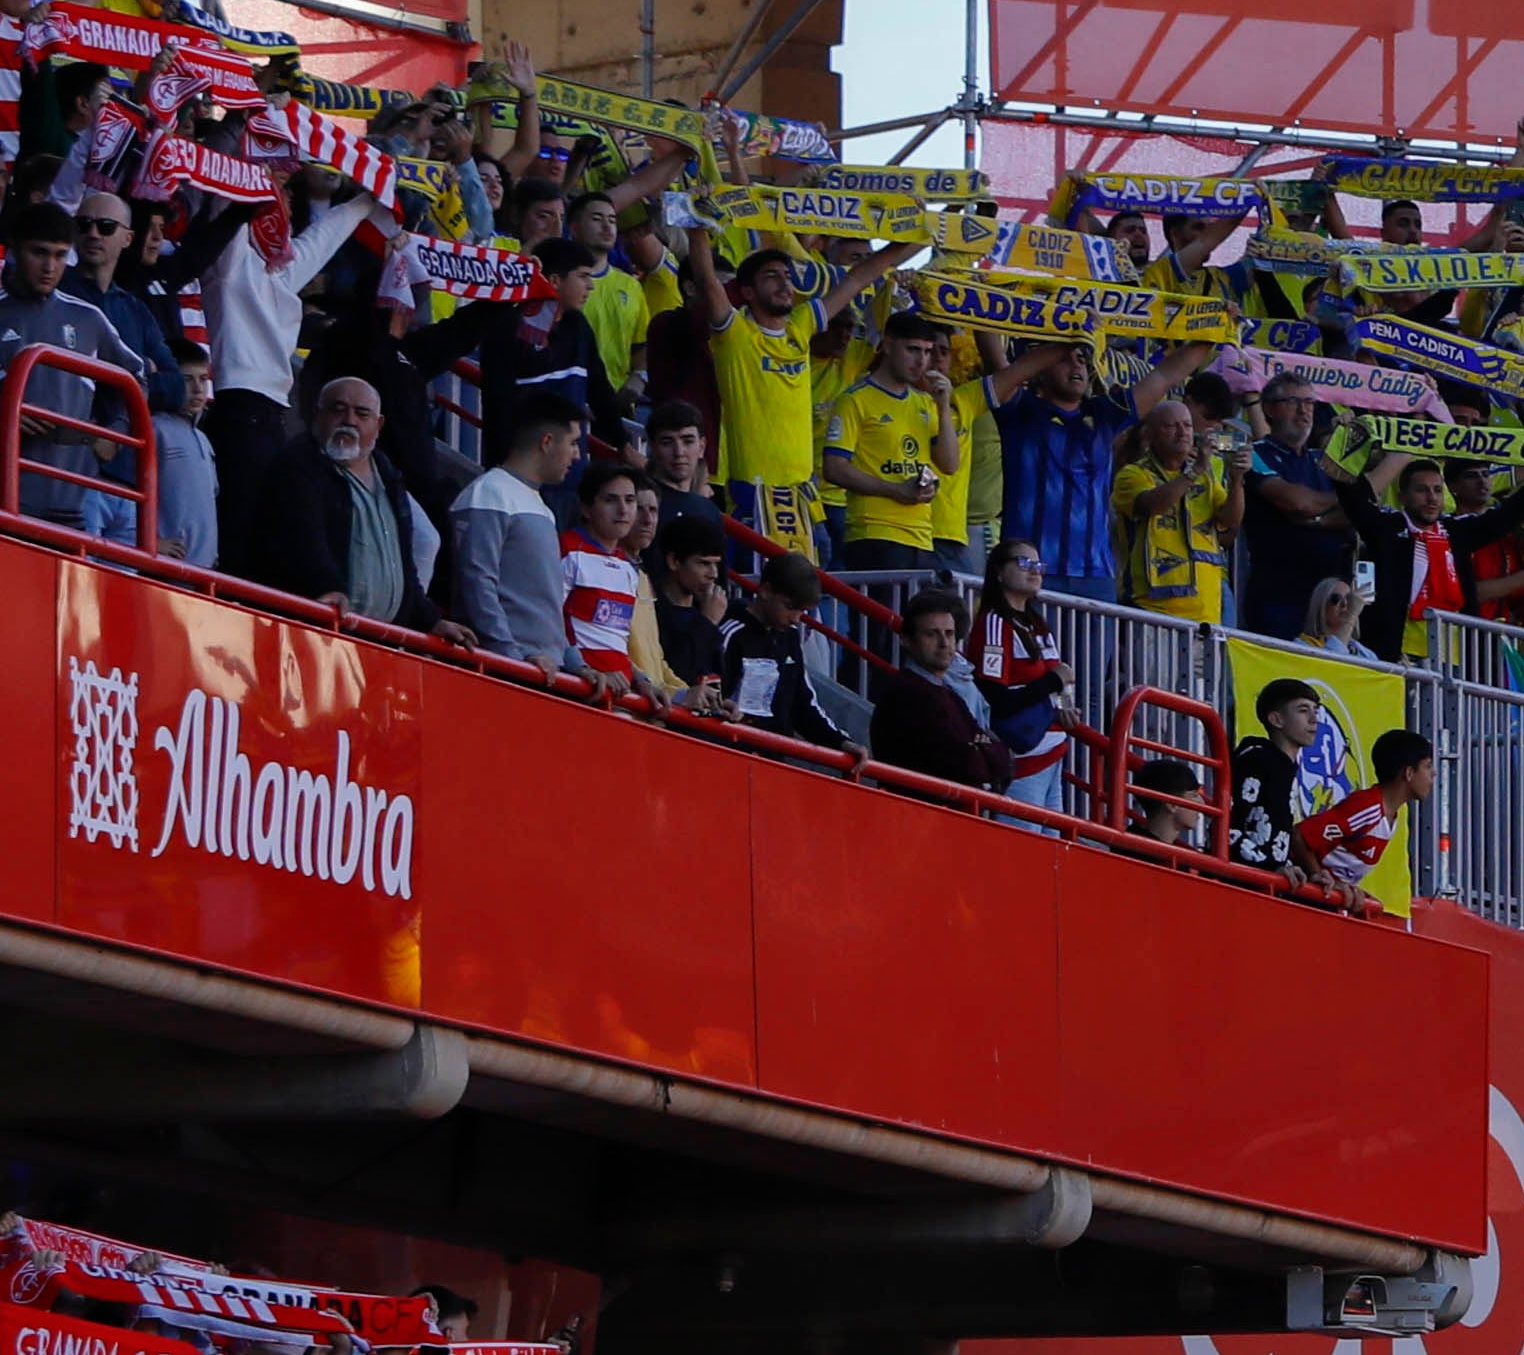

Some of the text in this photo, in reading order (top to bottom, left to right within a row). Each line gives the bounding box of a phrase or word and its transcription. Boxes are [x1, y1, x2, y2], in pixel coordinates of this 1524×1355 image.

[78, 20, 164, 58] GRANADA
[939, 285, 1044, 326] CADIZ
[1370, 321, 1466, 364] PEÑA CADISTA
[151, 688, 416, 901] Alhambra
